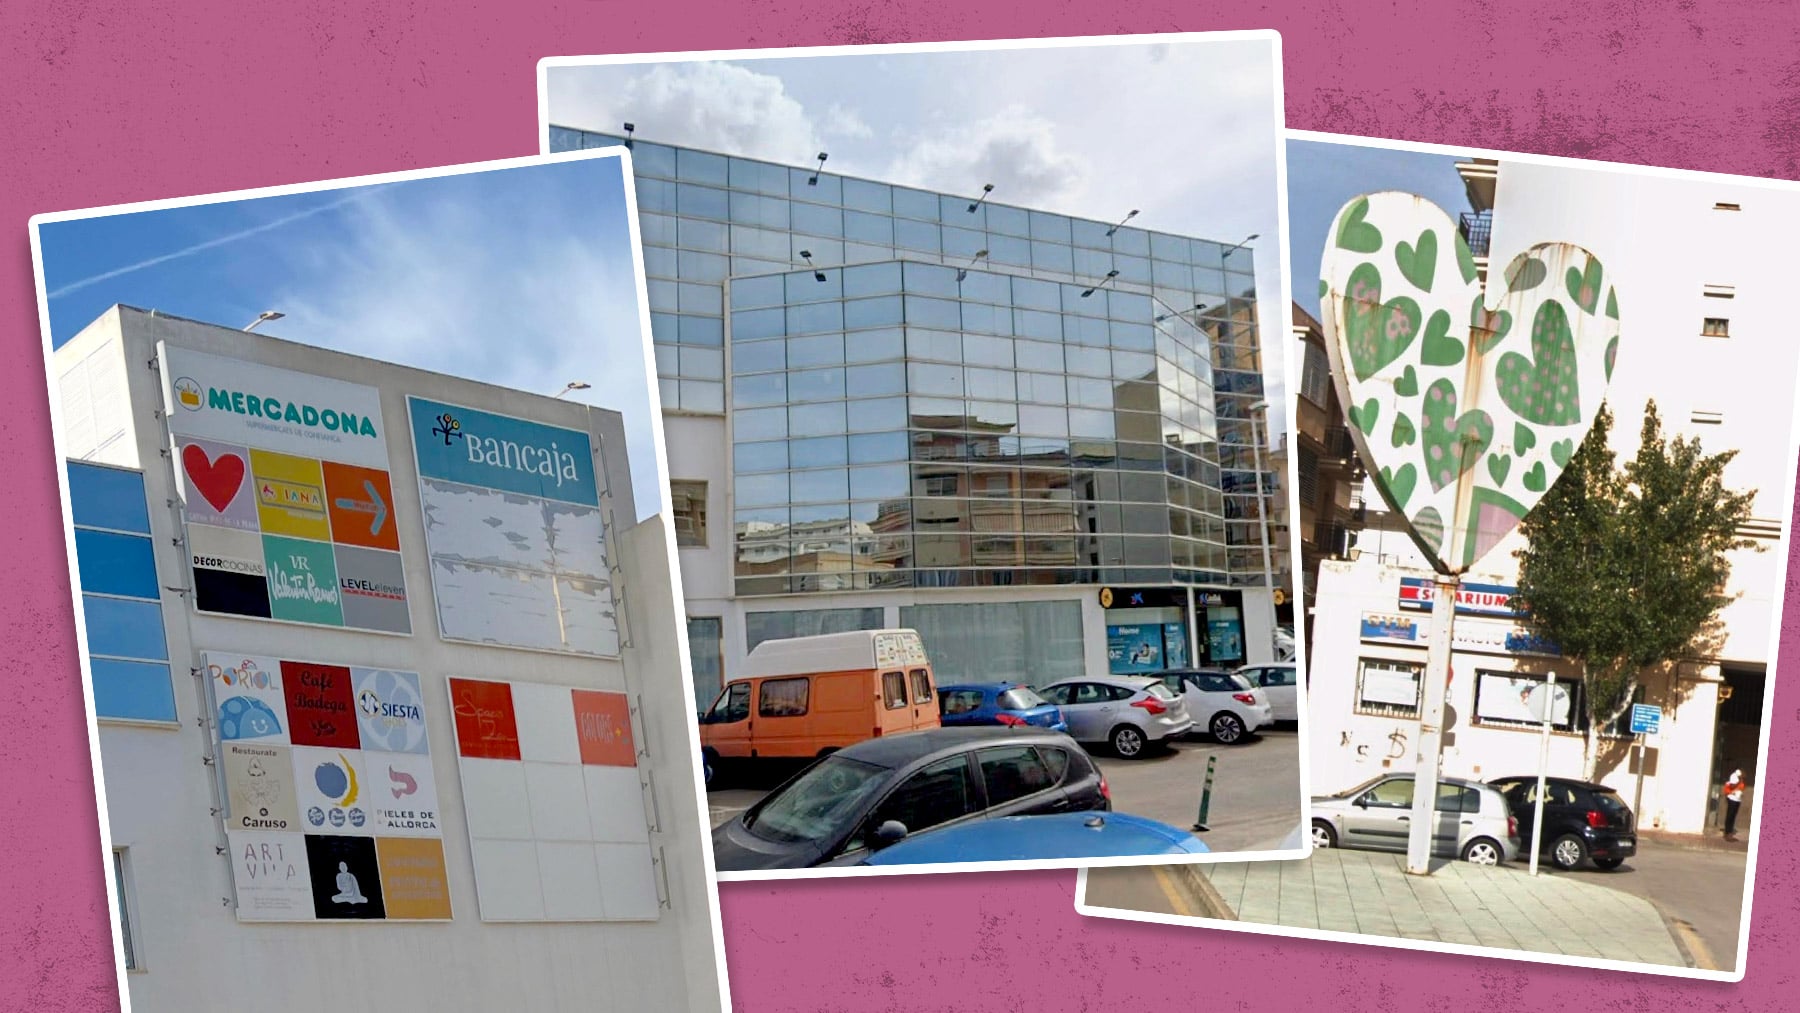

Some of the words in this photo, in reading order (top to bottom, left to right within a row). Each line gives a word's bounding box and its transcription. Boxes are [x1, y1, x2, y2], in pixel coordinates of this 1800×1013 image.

[208, 386, 377, 439] MERCADONA
[465, 433, 580, 488] Bancaja
[284, 490, 319, 504] IANA
[193, 556, 263, 574] DECORCOCINAS
[288, 555, 310, 570] VR
[341, 578, 405, 596] LEVELeleven
[1421, 589, 1509, 607] SARIUM
[300, 670, 334, 692] Café
[294, 692, 348, 714] Bodega
[381, 702, 420, 721] SIESTA
[242, 816, 288, 829] Caruso
[378, 819, 437, 829] ALLORCA
[420, 811, 435, 820] DE
[244, 842, 284, 862] ART
